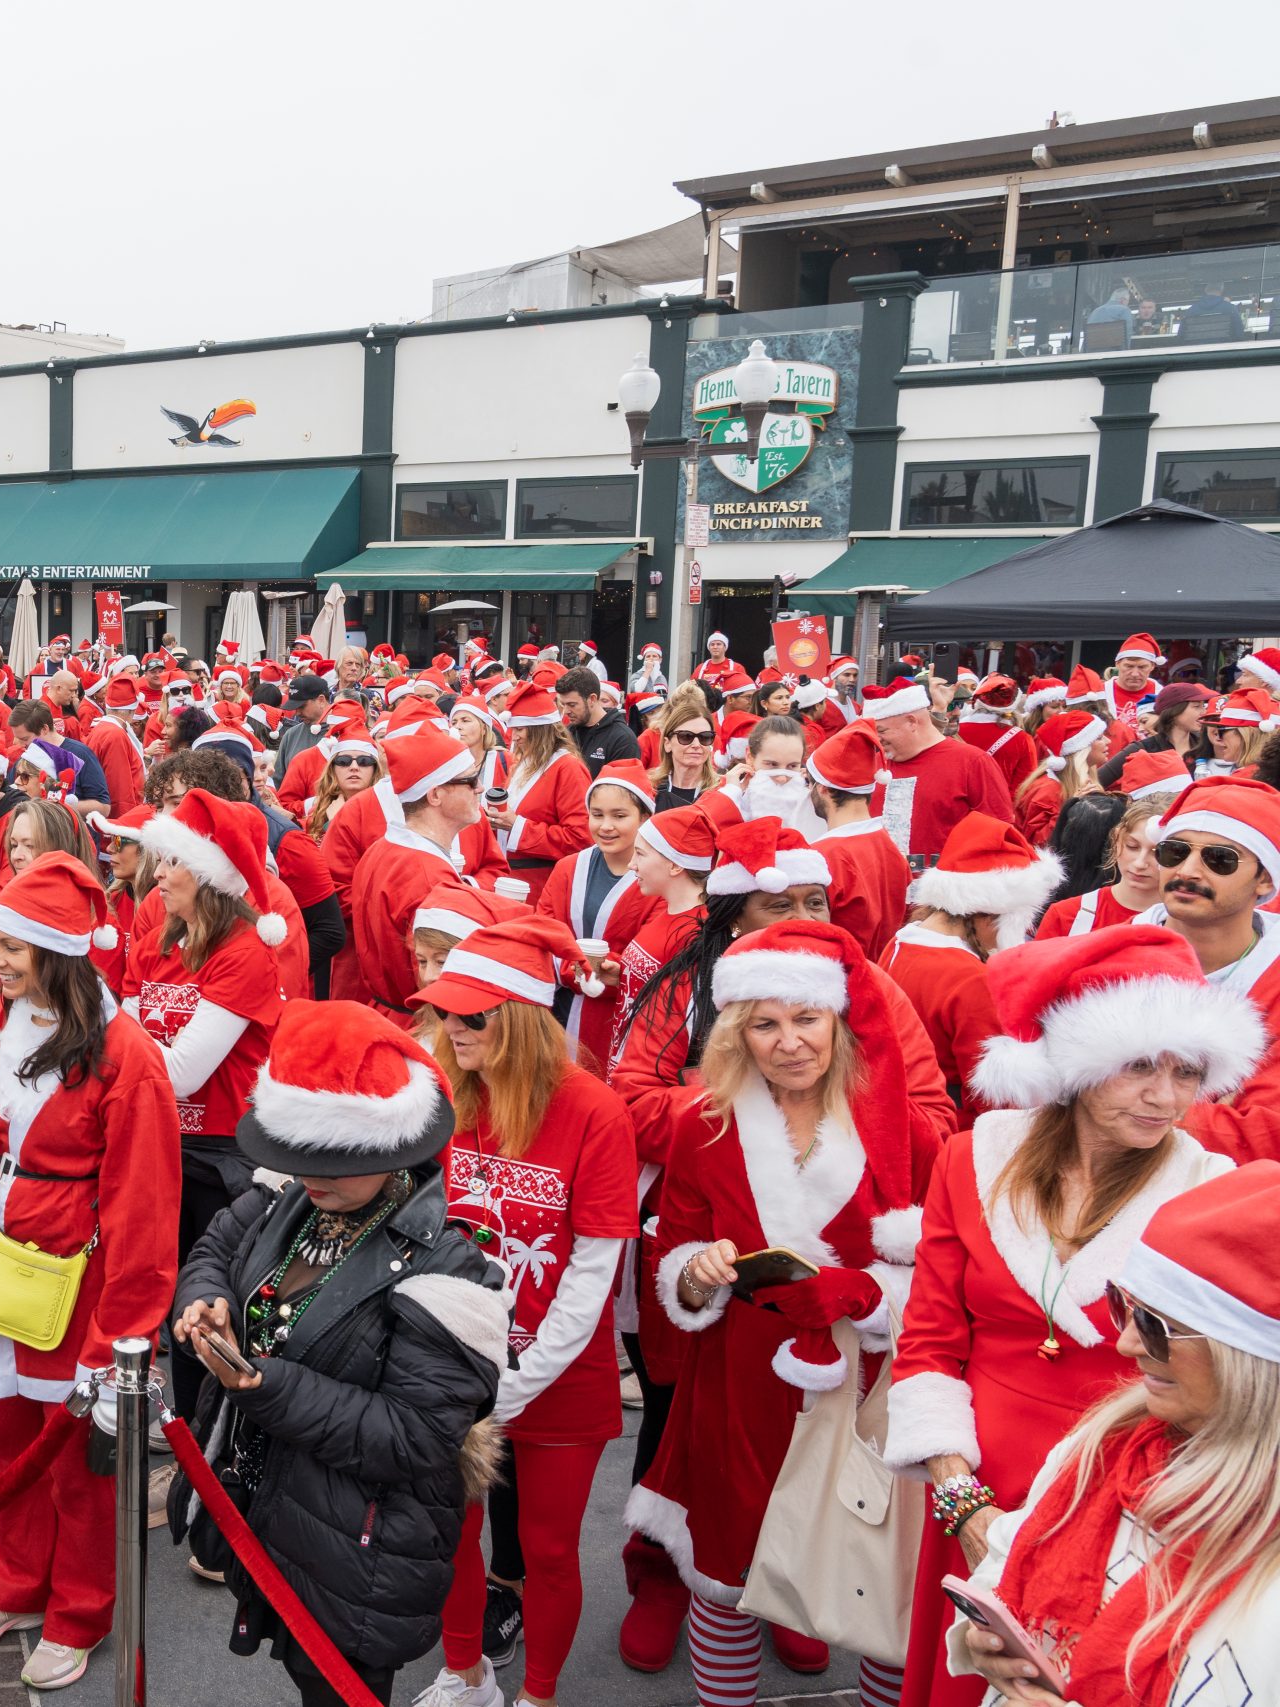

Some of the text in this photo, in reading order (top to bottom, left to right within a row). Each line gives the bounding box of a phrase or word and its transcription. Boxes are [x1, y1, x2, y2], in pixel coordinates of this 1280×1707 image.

[786, 368, 831, 397] Tavern
[765, 451, 785, 461] Est.
[765, 463, 787, 478] '76
[713, 500, 809, 514] BREAKFAST
[709, 516, 822, 530] UNCH DINNER
[42, 565, 151, 578] ENTERTAINMENT
[498, 1610, 522, 1639] HOKA
